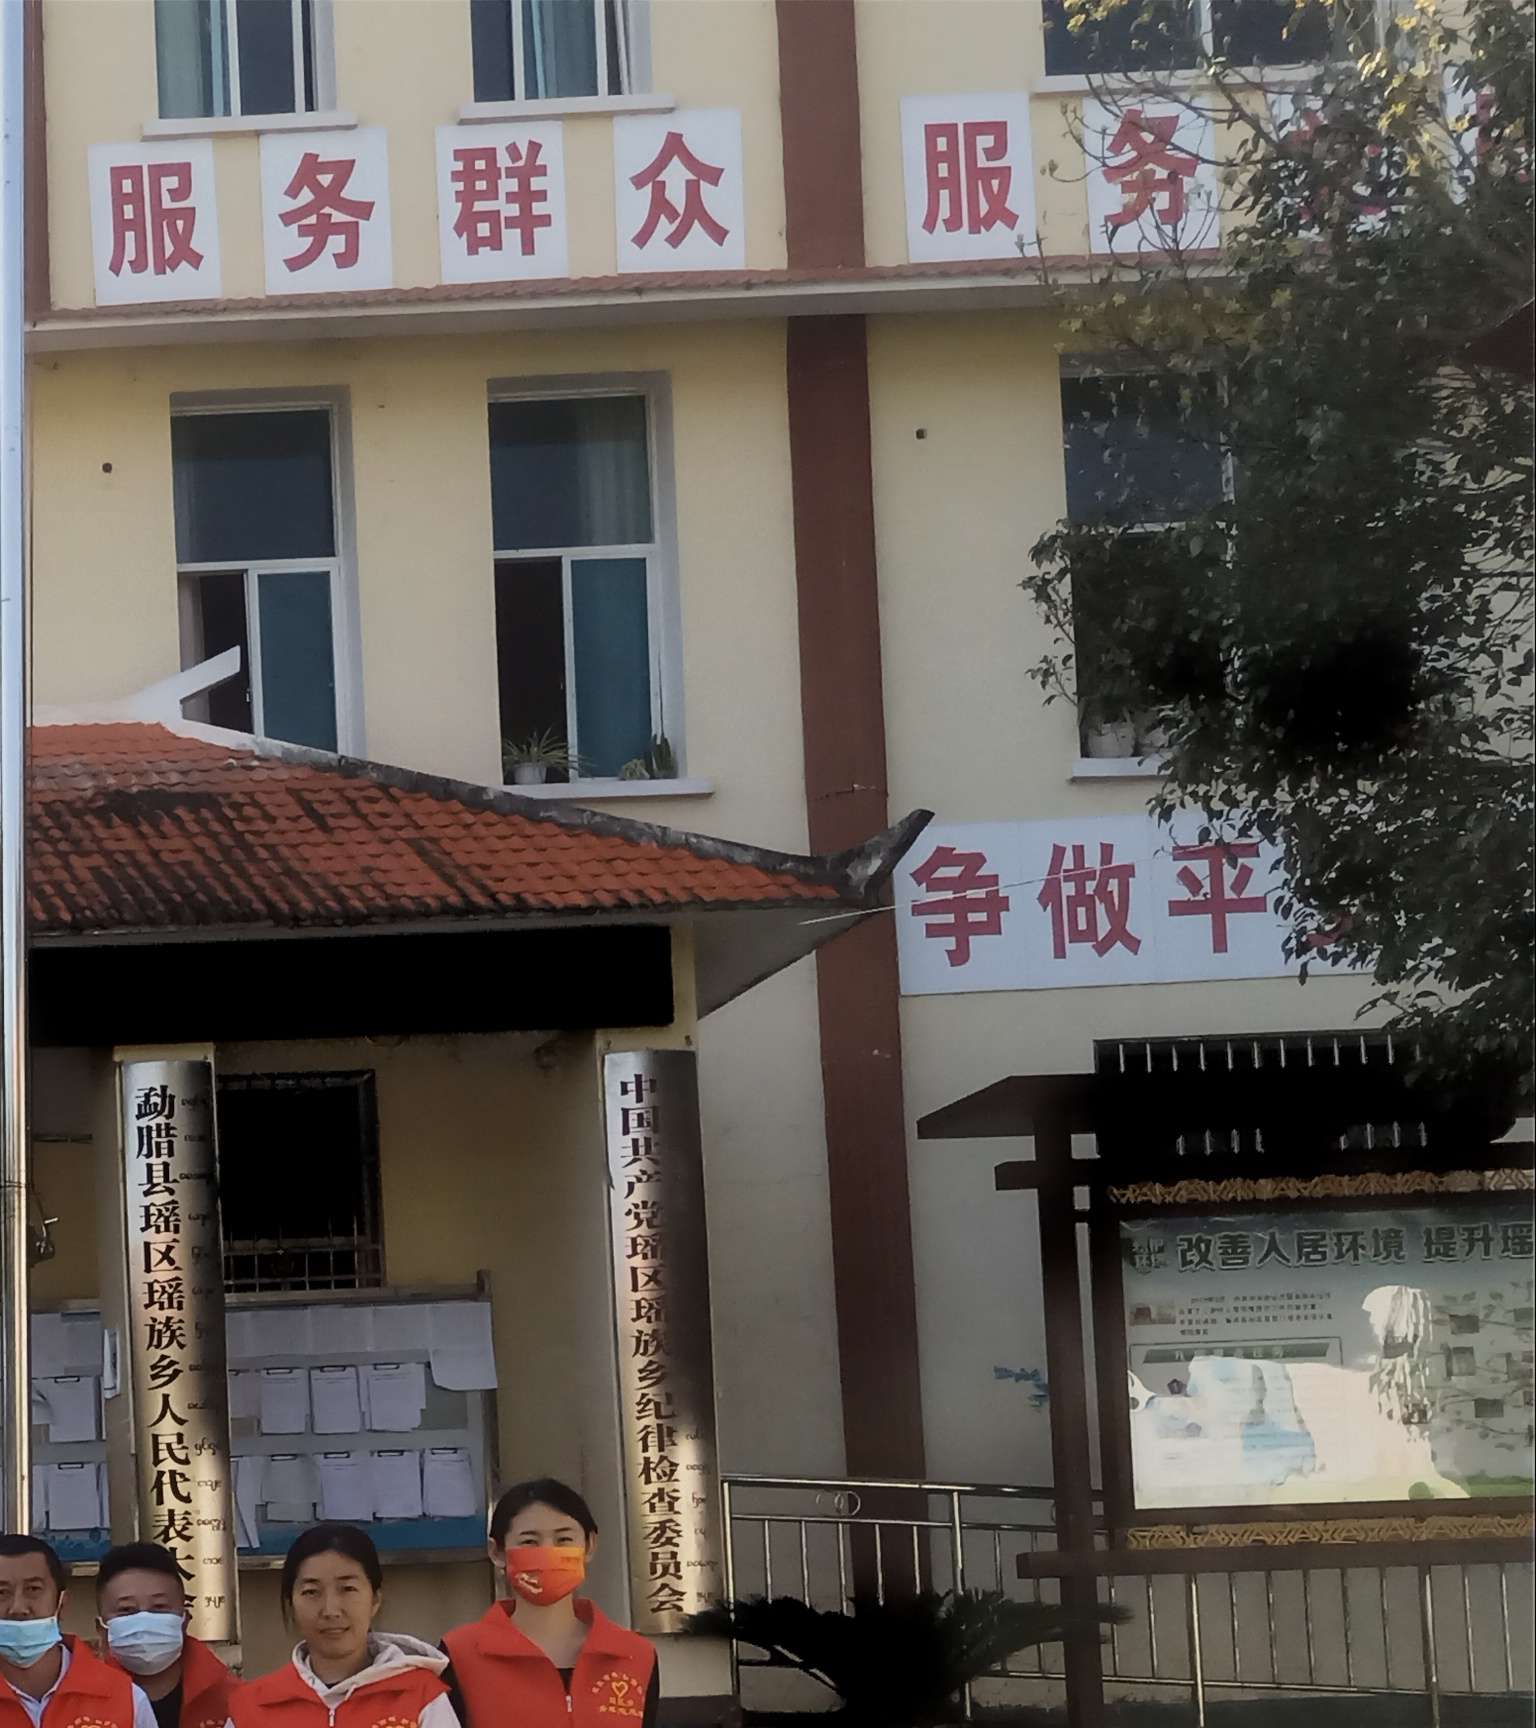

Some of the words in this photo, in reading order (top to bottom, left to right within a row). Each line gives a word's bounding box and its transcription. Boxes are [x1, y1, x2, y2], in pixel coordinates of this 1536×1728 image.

[108, 129, 729, 278] 服务群众
[910, 842, 1356, 968] 争做平
[1176, 1227, 1407, 1272] 改善人居环境
[135, 1084, 197, 1623] 勐腊县瑶区瑶族乡人民代表
[620, 1073, 687, 1614] 中国共产党瑶区瑶族乡纪律检查委员会
